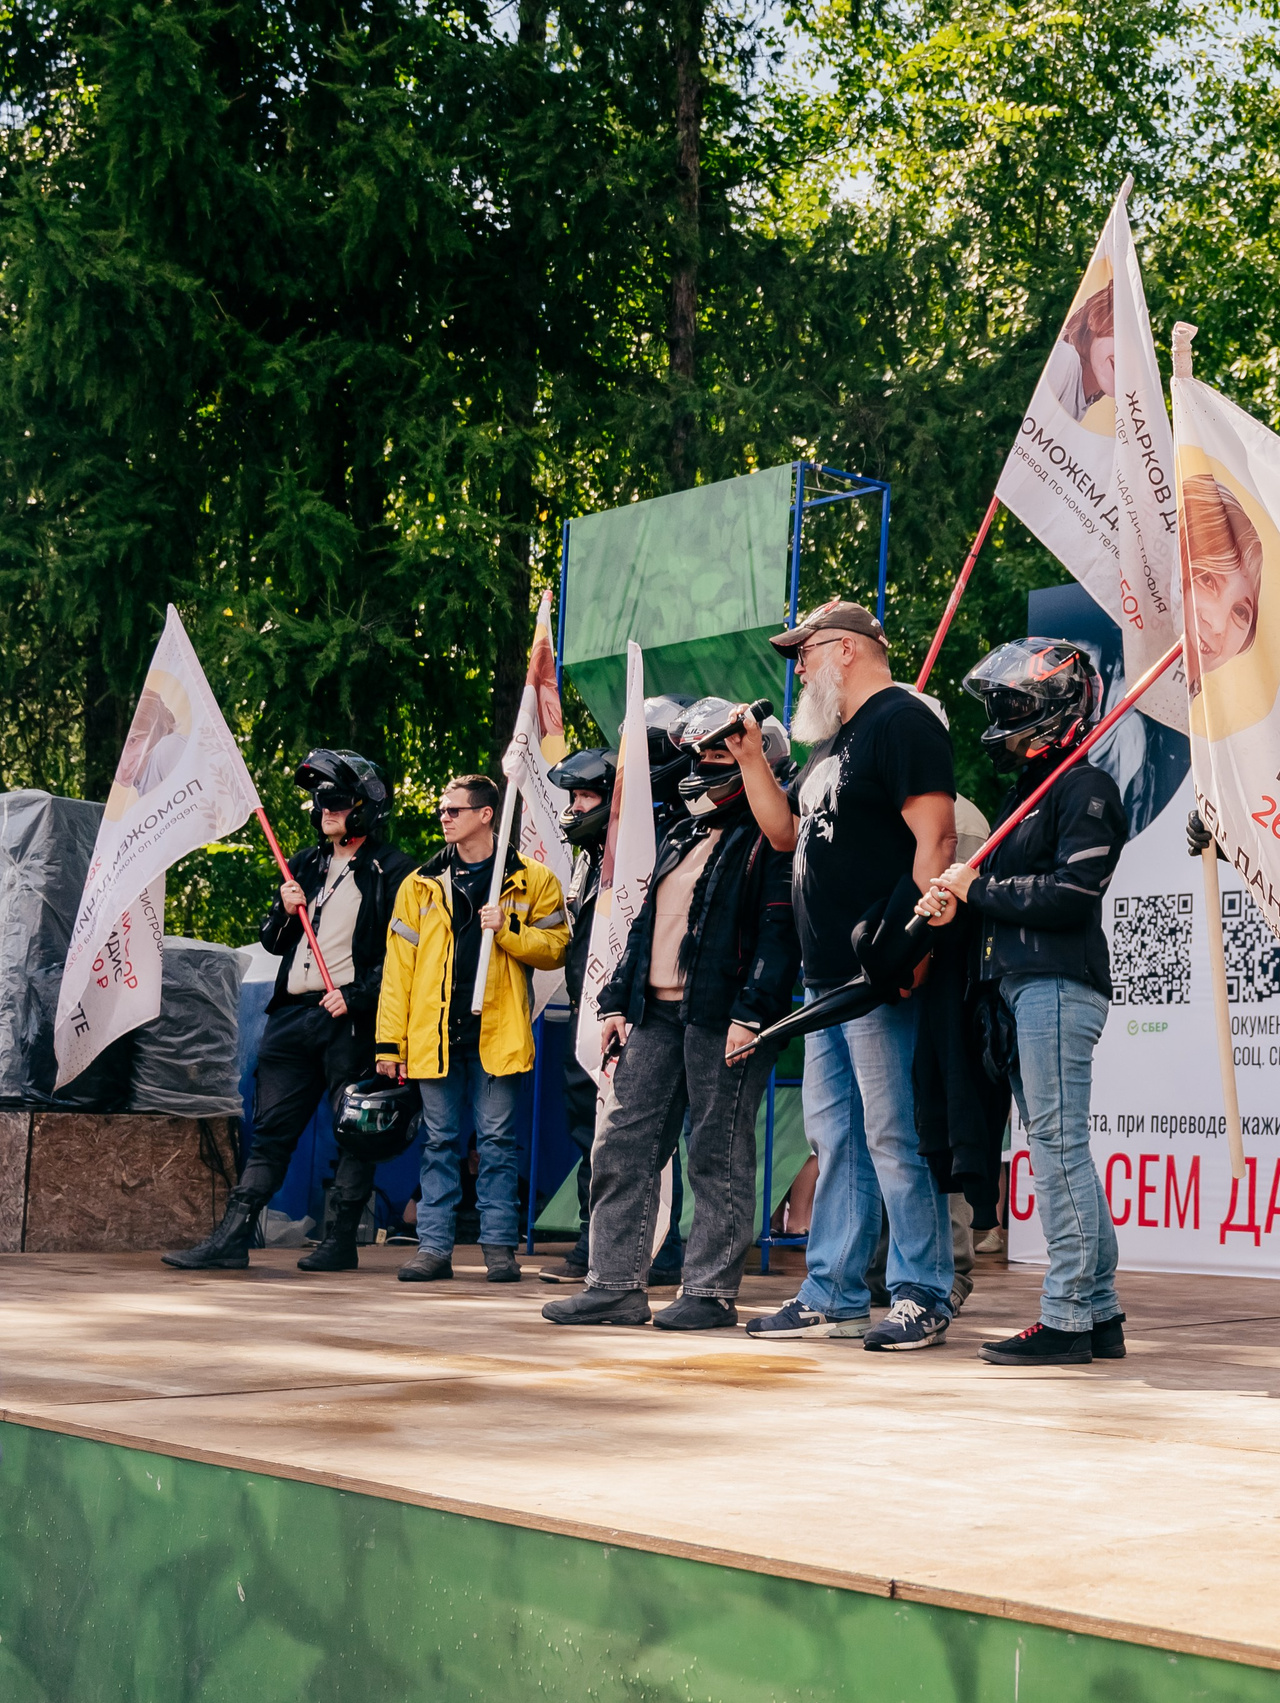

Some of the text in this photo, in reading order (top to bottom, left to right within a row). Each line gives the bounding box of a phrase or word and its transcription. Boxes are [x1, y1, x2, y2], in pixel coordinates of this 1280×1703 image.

[1062, 493, 1100, 535] номеру
[1141, 1022, 1169, 1033] СБЕР
[1232, 1046, 1265, 1069] СОЦ.
[1117, 1114, 1145, 1138] при
[1150, 1115, 1227, 1139] переводе
